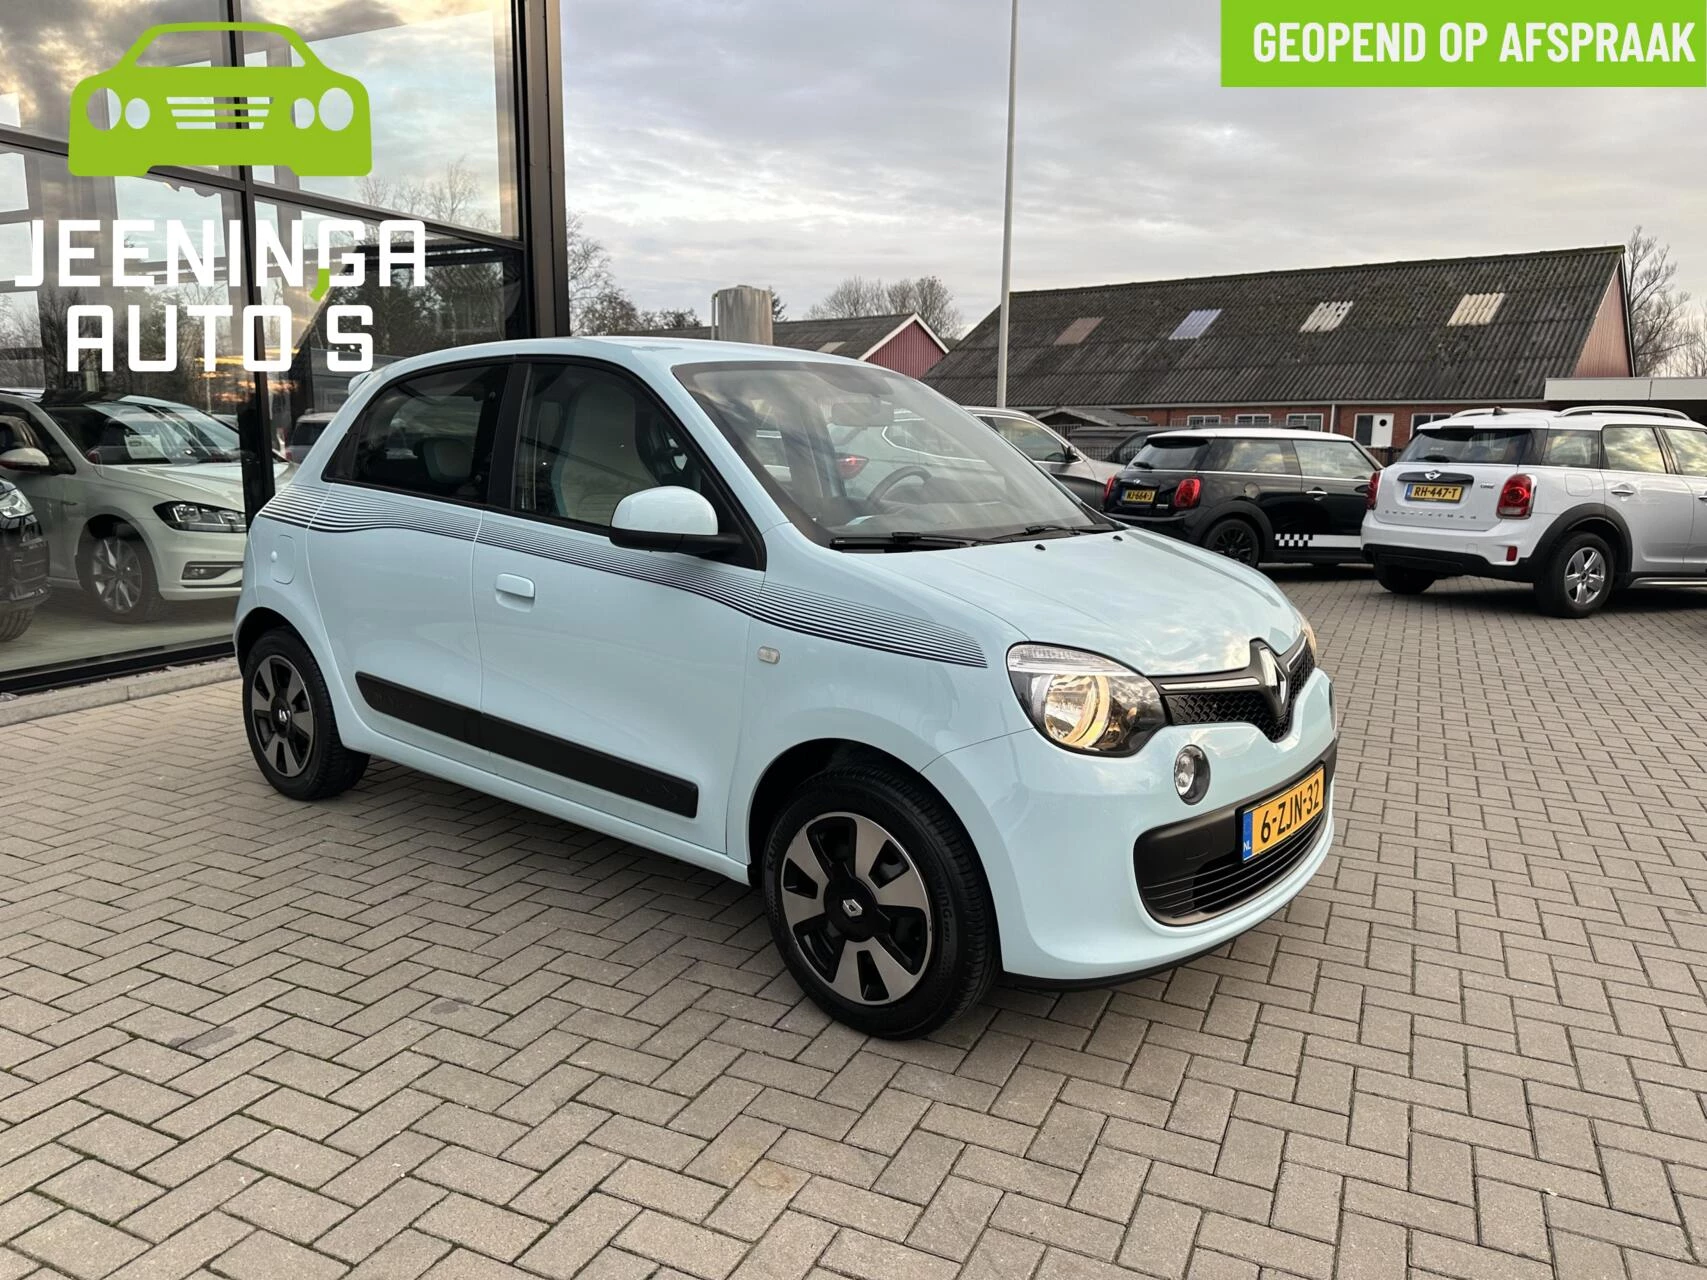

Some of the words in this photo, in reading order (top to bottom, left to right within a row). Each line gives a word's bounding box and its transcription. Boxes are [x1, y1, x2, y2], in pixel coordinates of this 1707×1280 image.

[1413, 486, 1458, 498] RH-447-T
[1260, 778, 1320, 844] 6-ZJN-32
[1243, 840, 1252, 853] NL
